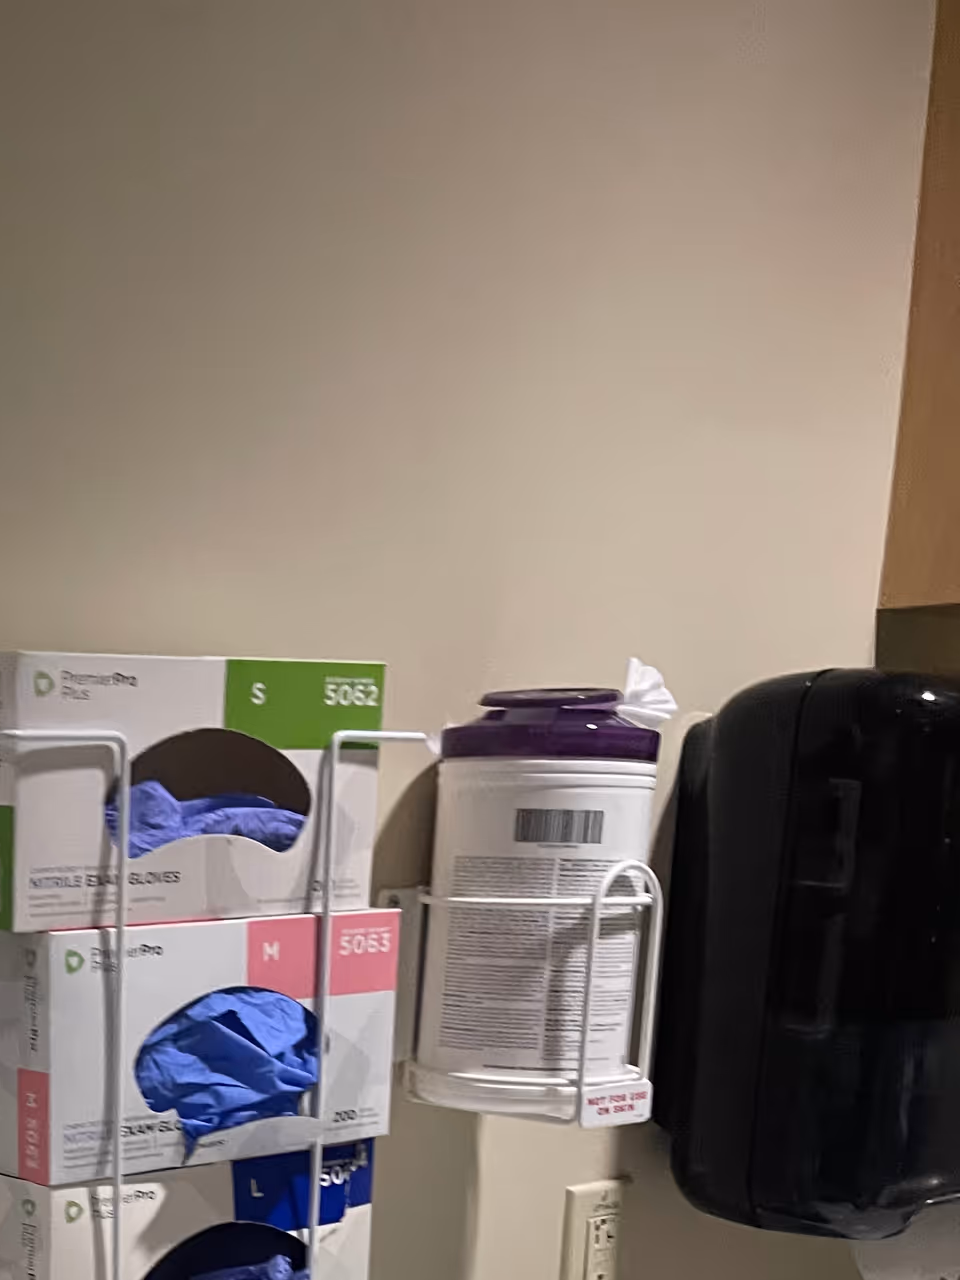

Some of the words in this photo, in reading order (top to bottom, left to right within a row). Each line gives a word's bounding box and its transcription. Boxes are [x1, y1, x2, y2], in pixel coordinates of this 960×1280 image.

[250, 682, 267, 705] S
[323, 683, 379, 706] 5062
[127, 870, 182, 886] GLOVES
[262, 941, 279, 962] M
[339, 932, 391, 956] 5063
[250, 1178, 264, 1197] L
